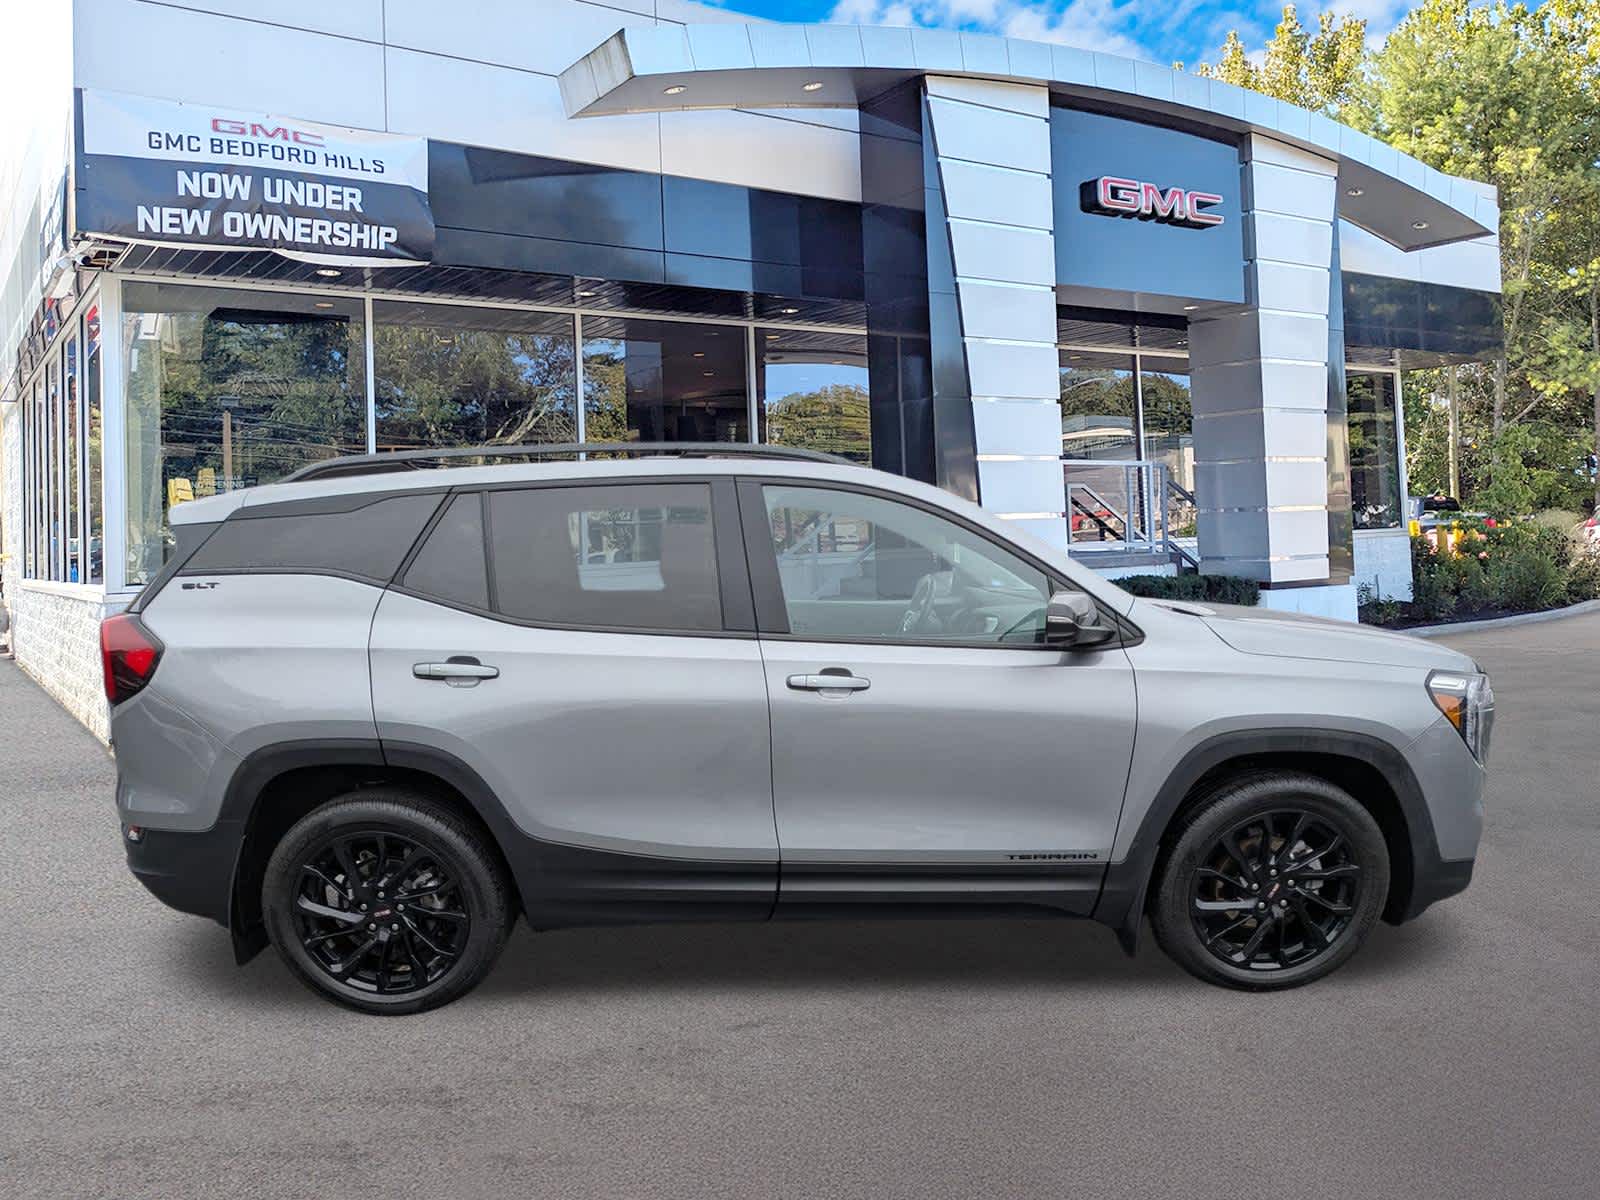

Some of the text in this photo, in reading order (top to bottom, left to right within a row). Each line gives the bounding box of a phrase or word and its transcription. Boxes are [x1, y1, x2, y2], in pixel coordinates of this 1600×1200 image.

[148, 131, 385, 175] GMC BEDFORD HILLS
[211, 118, 325, 147] GMC
[177, 170, 363, 213] NOW UNDER
[1097, 175, 1225, 225] GMC
[137, 206, 398, 250] NEW OWNERSHIP
